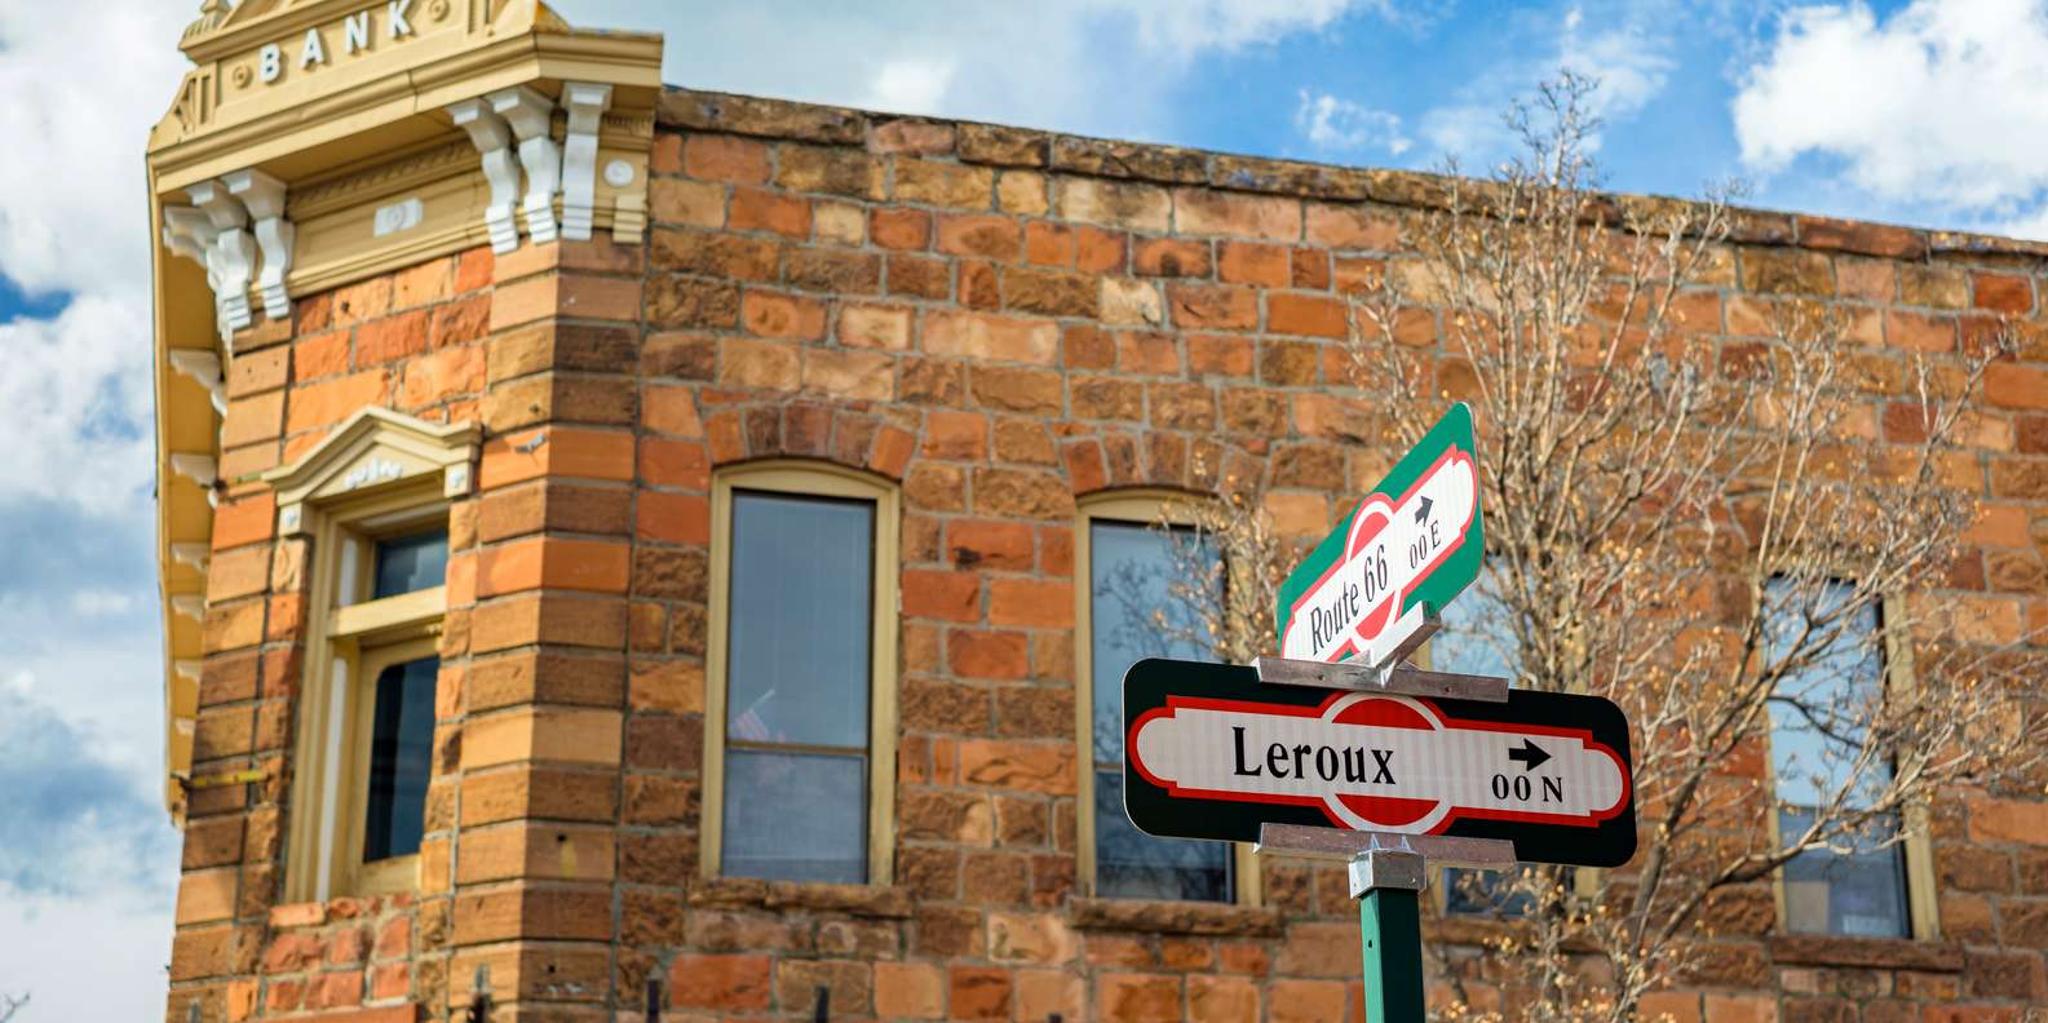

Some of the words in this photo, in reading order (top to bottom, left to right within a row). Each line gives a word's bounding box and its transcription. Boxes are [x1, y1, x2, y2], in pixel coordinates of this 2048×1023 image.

[260, 0, 412, 82] BANK
[1409, 534, 1428, 570] 00
[1431, 519, 1441, 549] E
[1310, 581, 1360, 656] Route
[1364, 544, 1388, 603] 66
[1232, 726, 1397, 785] Leroux
[1491, 774, 1532, 801] 00
[1541, 776, 1564, 803] N
